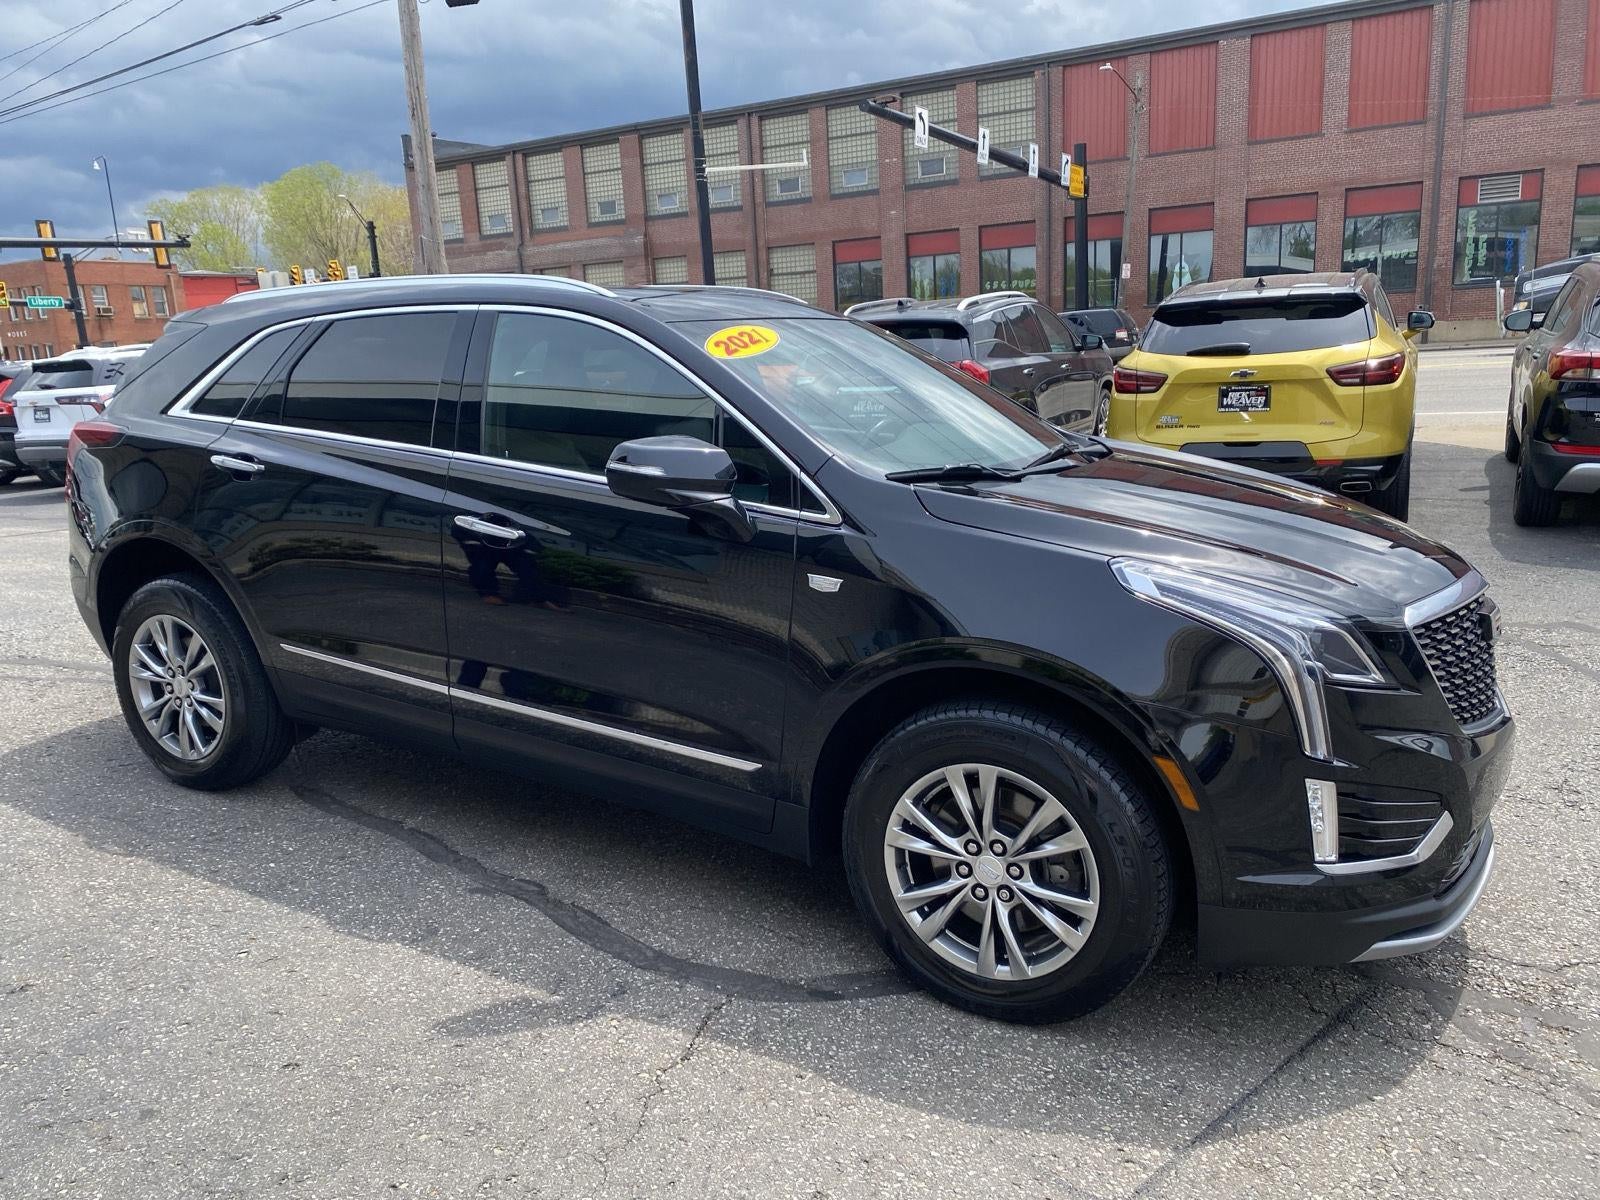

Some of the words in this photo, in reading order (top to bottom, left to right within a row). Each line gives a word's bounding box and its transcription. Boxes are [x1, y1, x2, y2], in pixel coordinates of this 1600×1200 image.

[1011, 279, 1037, 289] PUPS
[31, 298, 59, 307] Liberty
[714, 328, 770, 356] 2021
[1227, 391, 1249, 399] RICK
[1223, 396, 1266, 406] WEAVER
